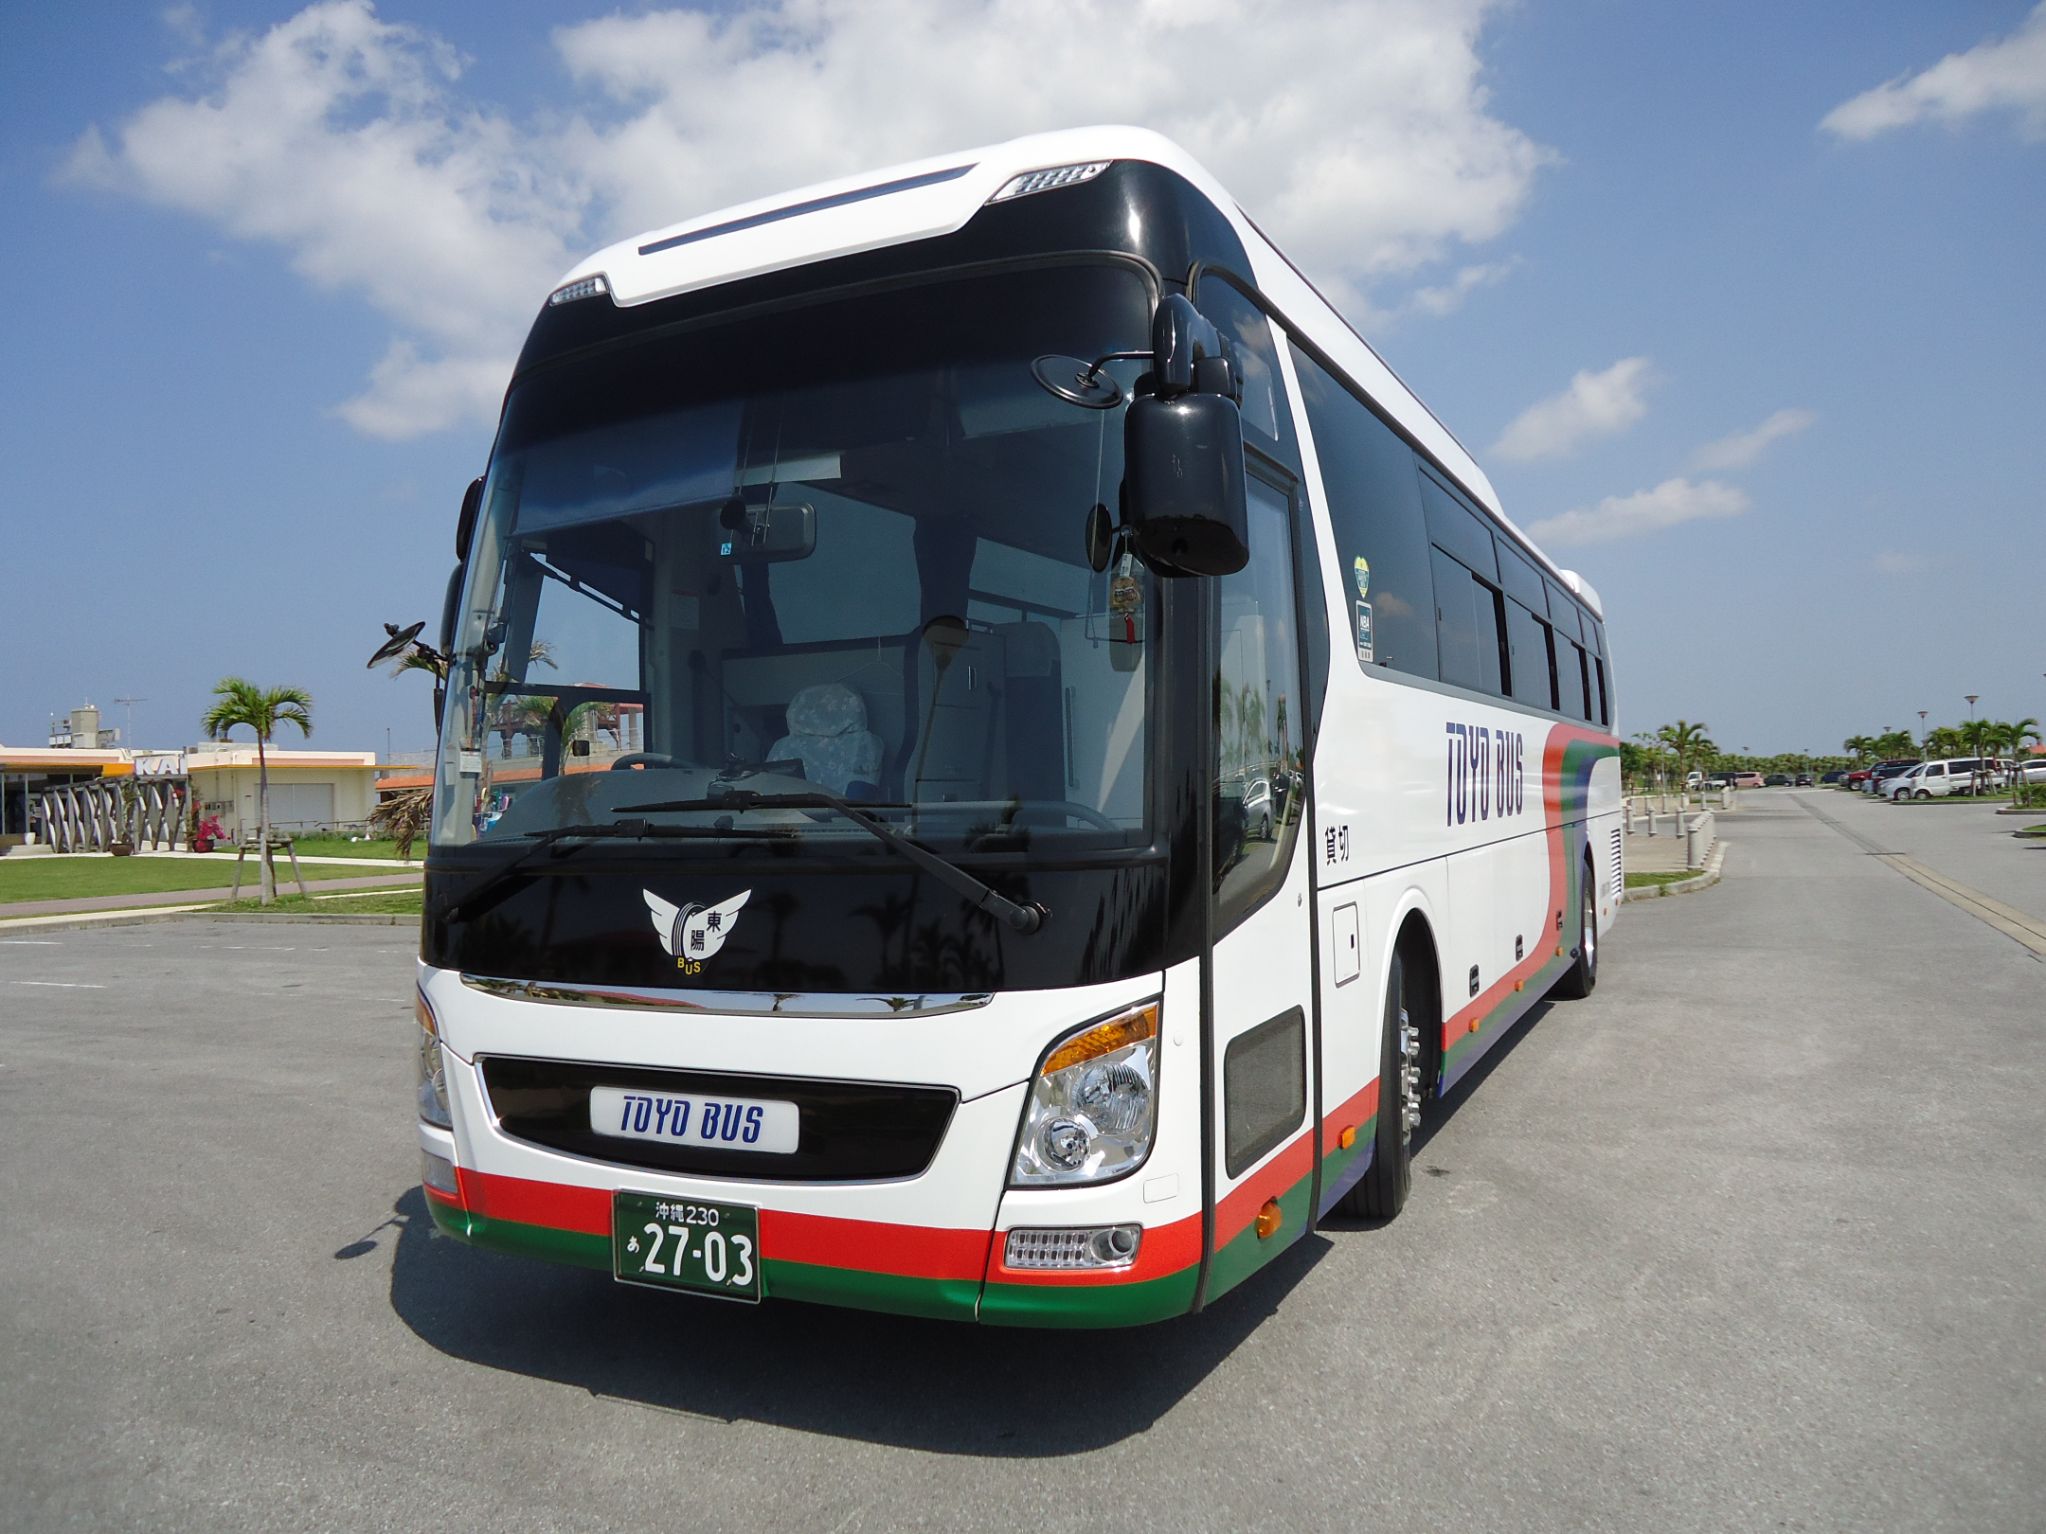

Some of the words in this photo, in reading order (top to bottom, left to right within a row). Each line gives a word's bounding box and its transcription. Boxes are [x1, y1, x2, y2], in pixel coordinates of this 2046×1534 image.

[1446, 722, 1489, 826] TOYO
[1496, 730, 1523, 818] BUS
[1325, 825, 1349, 866] 貸切
[677, 957, 701, 975] BUS
[621, 1096, 691, 1137] TOYO
[701, 1102, 763, 1143] BUS
[643, 1223, 753, 1286] 27-03
